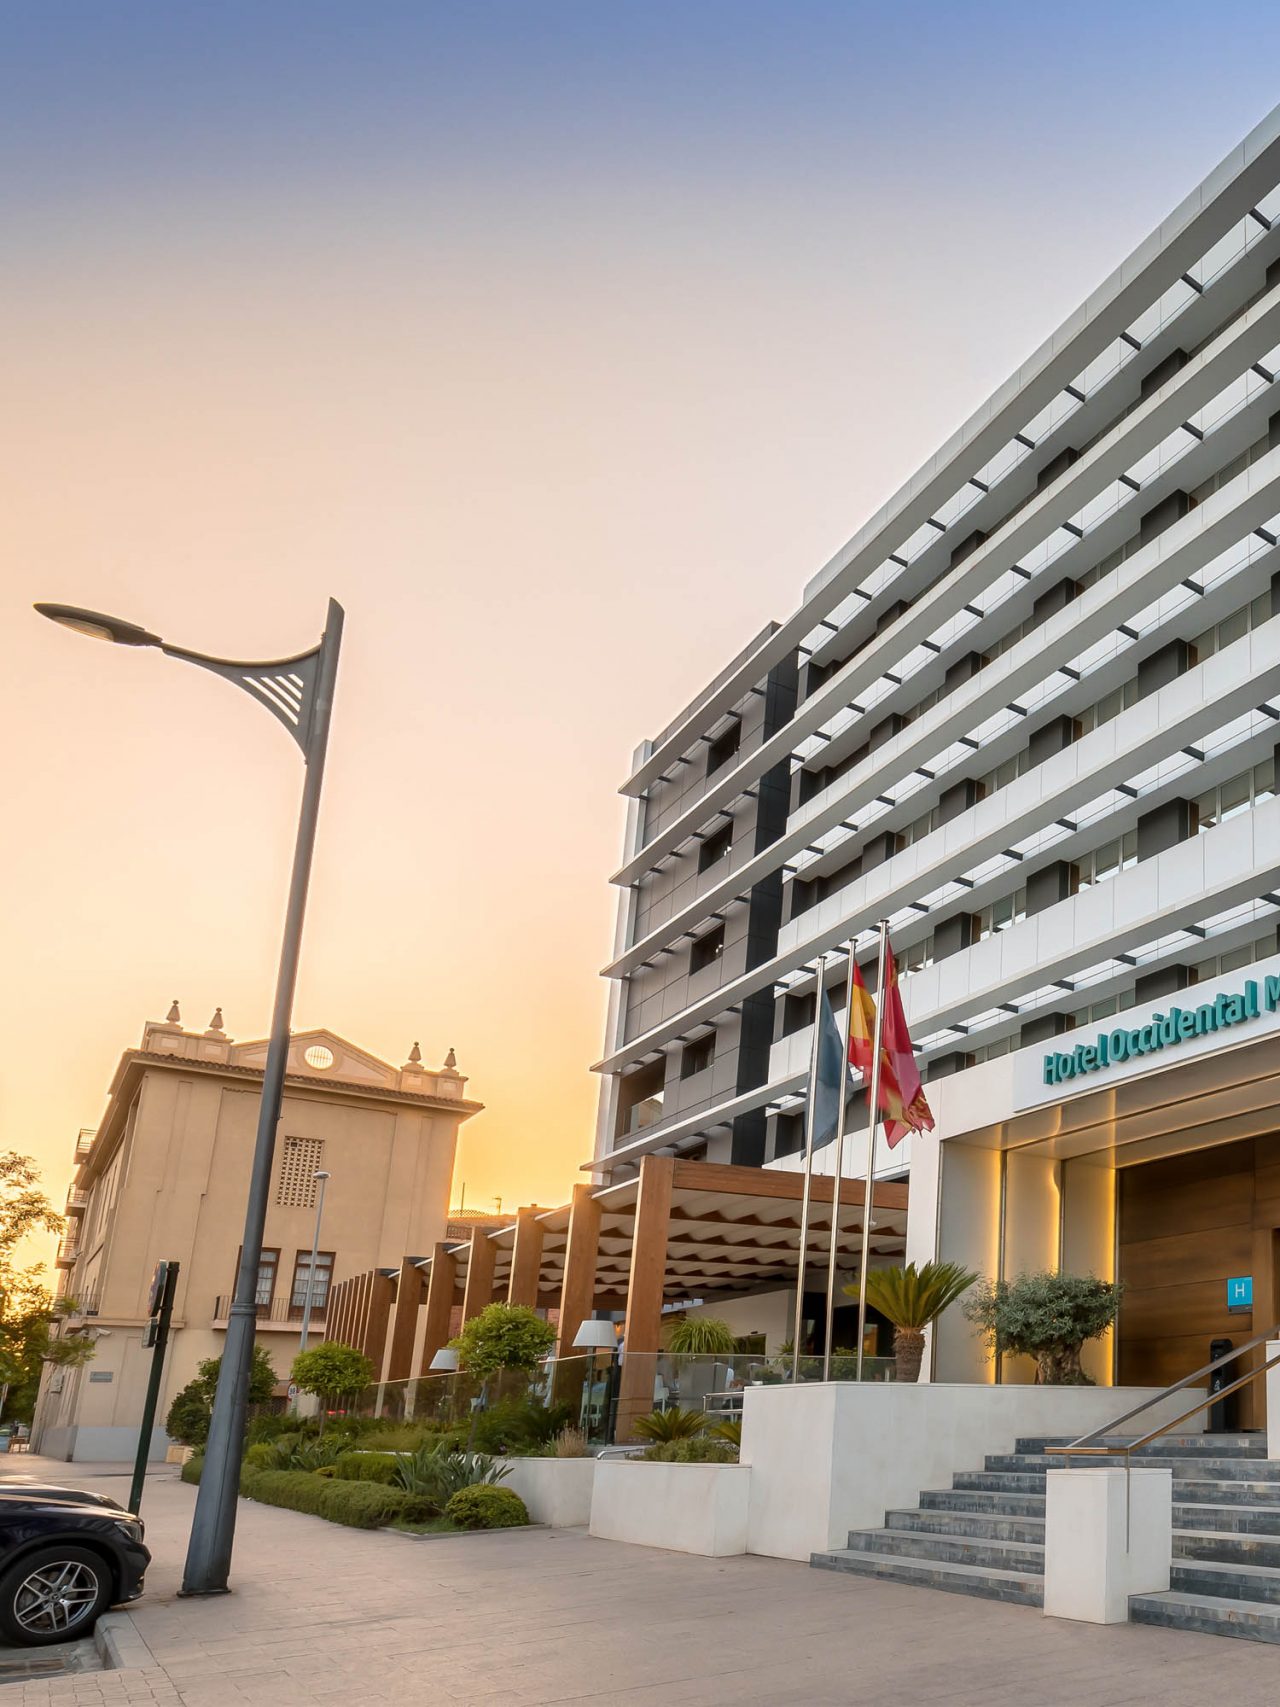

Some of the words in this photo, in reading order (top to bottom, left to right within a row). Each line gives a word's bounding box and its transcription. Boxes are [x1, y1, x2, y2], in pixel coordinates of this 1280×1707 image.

[1043, 1033, 1109, 1085] Hotel
[1108, 980, 1260, 1062] Occidental
[1235, 1282, 1245, 1298] H
